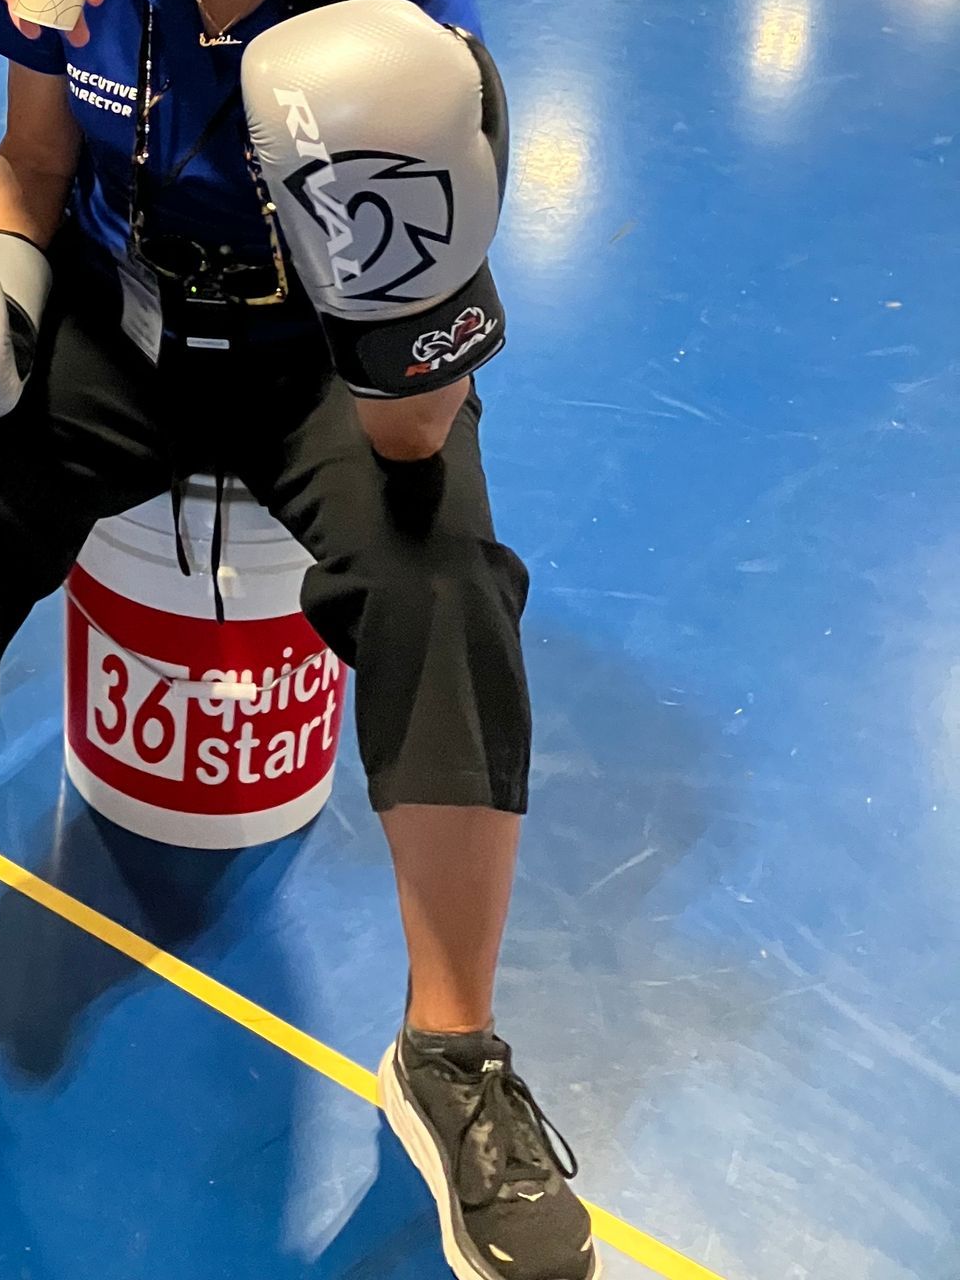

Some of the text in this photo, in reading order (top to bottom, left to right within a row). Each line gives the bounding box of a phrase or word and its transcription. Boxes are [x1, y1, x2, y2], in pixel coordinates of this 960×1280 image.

[66, 62, 139, 101] EXECUTIVE
[272, 87, 362, 290] RIVAL
[94, 653, 176, 764] 36
[195, 690, 337, 786] start
